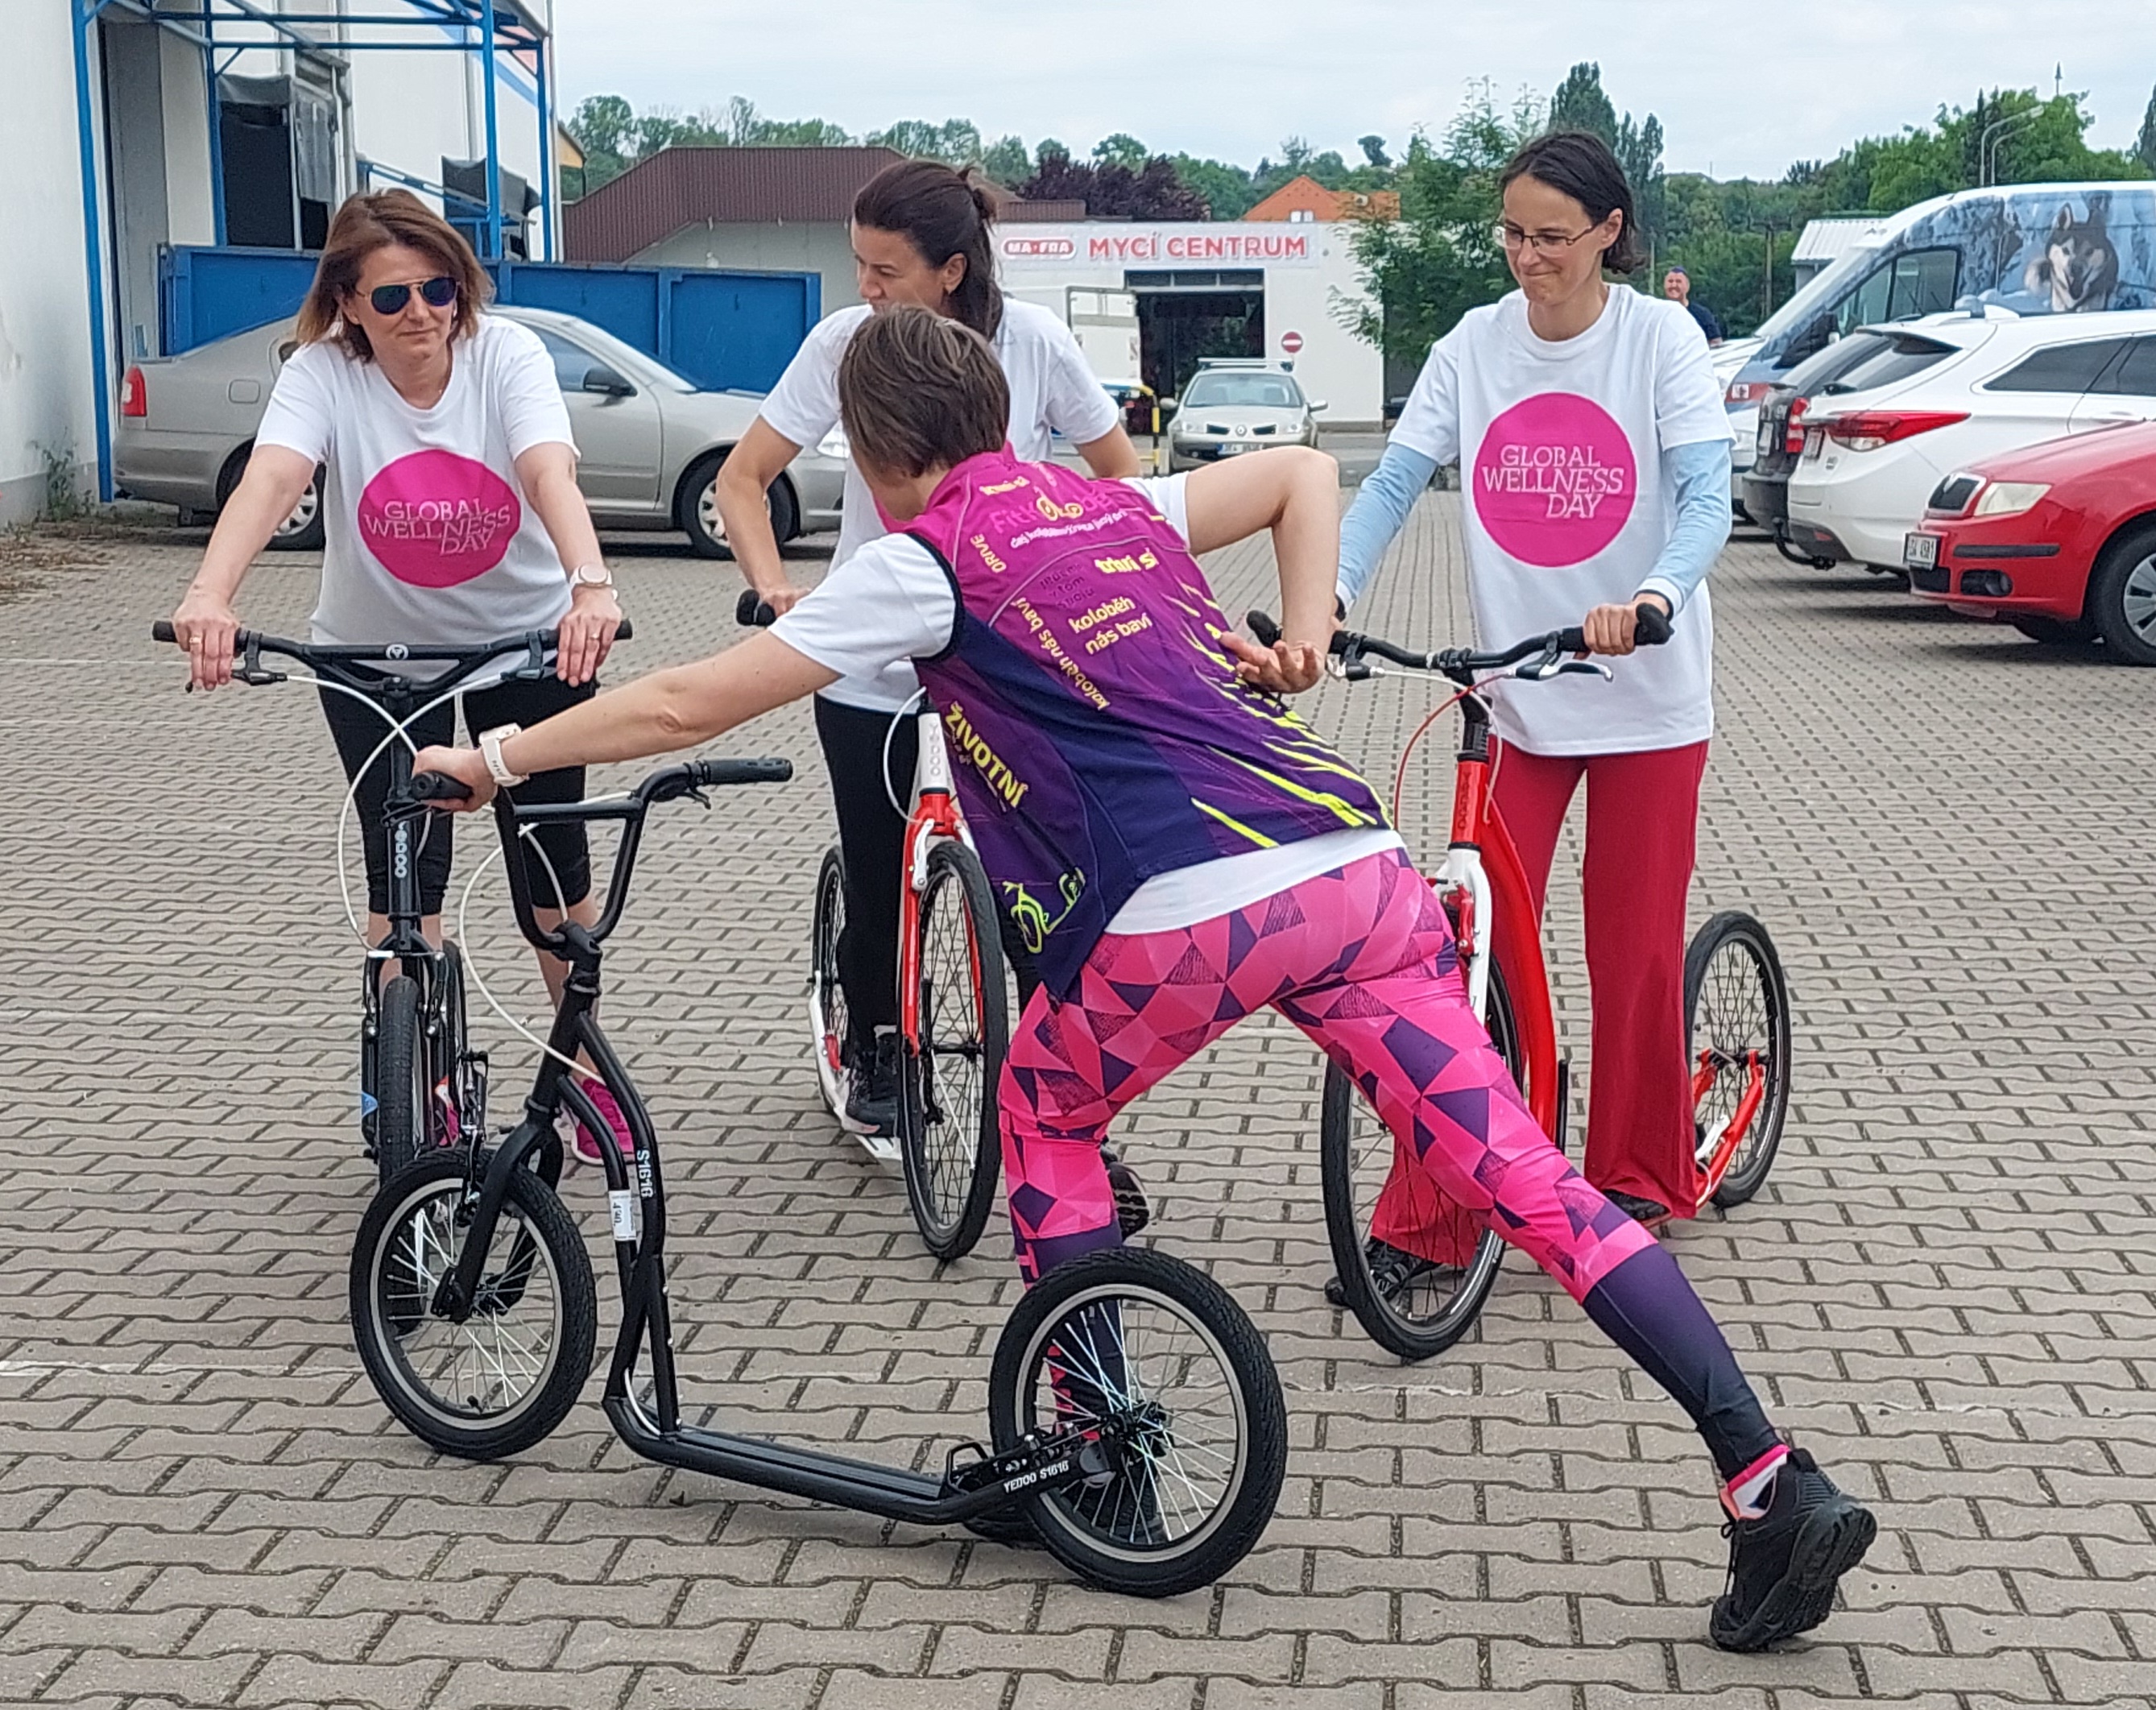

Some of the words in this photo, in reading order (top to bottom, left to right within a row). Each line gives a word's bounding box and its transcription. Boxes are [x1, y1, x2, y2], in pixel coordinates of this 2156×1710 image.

[1089, 231, 1158, 258] MYCÍ
[1167, 236, 1306, 258] CENTRUM
[1500, 444, 1601, 467] GLOBAL
[1482, 466, 1624, 495] WELLNESS
[383, 498, 490, 522] GLOBAL
[1546, 493, 1604, 519] DAY
[363, 505, 511, 540] WELLNESS
[440, 528, 495, 557] DAY
[1068, 596, 1136, 634] koloběh
[1038, 629, 1064, 658] nás
[1085, 630, 1119, 655] nás
[945, 701, 1029, 808] ŽIVOTNÍ
[1004, 1472, 1037, 1493] YEDOO
[1040, 1460, 1070, 1480] S1616
